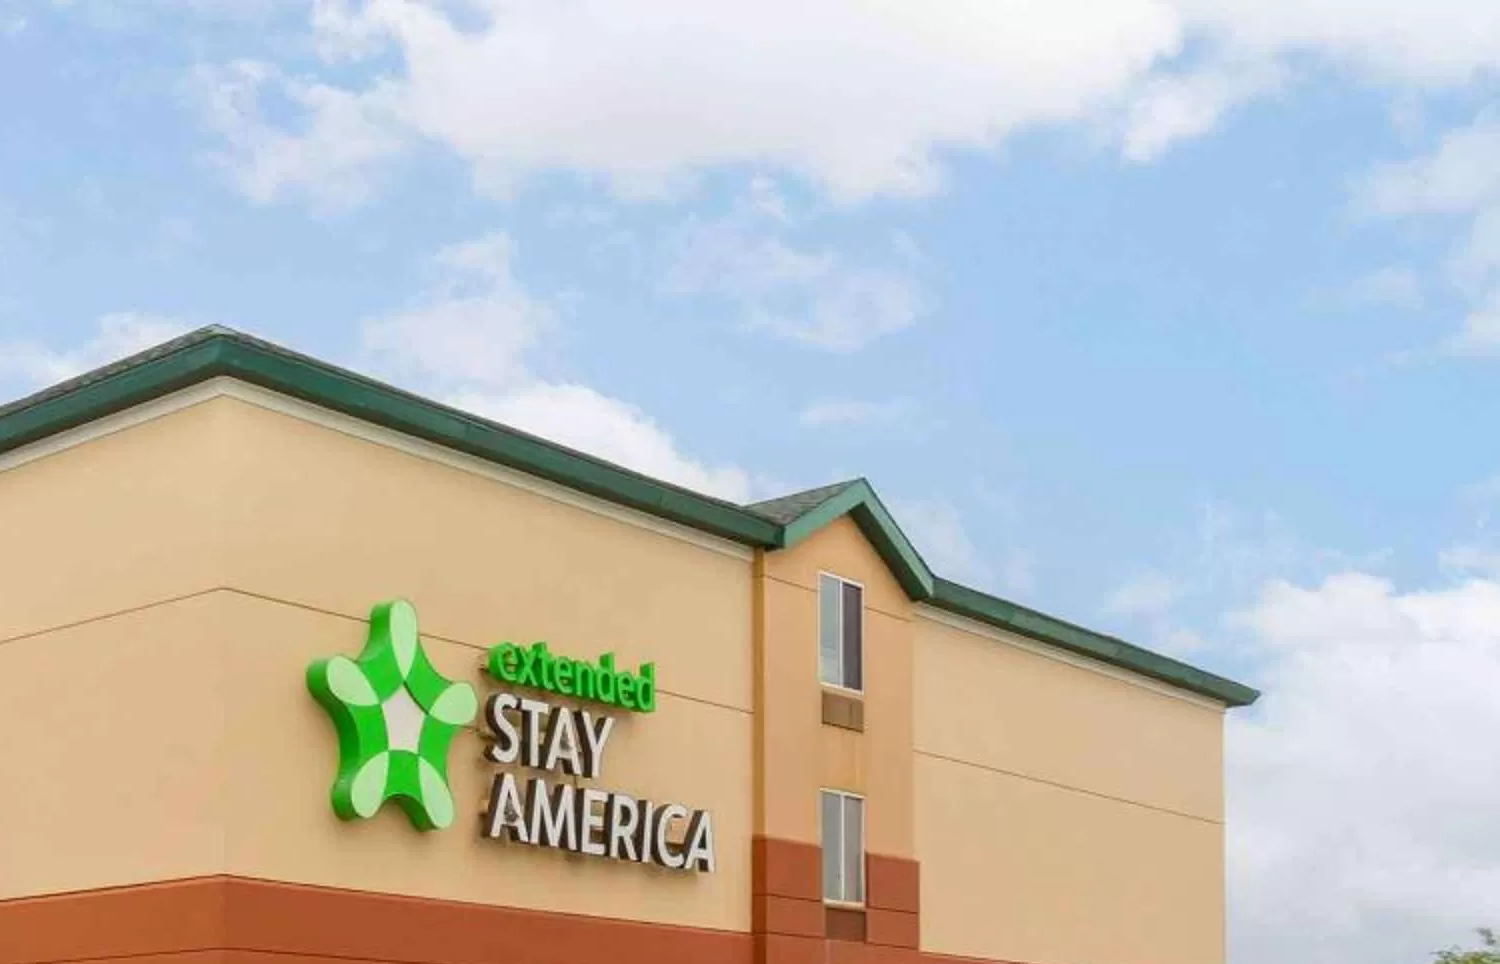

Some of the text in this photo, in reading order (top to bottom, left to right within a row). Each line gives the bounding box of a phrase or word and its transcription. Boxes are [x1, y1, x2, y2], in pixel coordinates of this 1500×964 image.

[488, 641, 656, 713] extended
[487, 693, 614, 778] STAY
[486, 773, 715, 873] AMERICA
